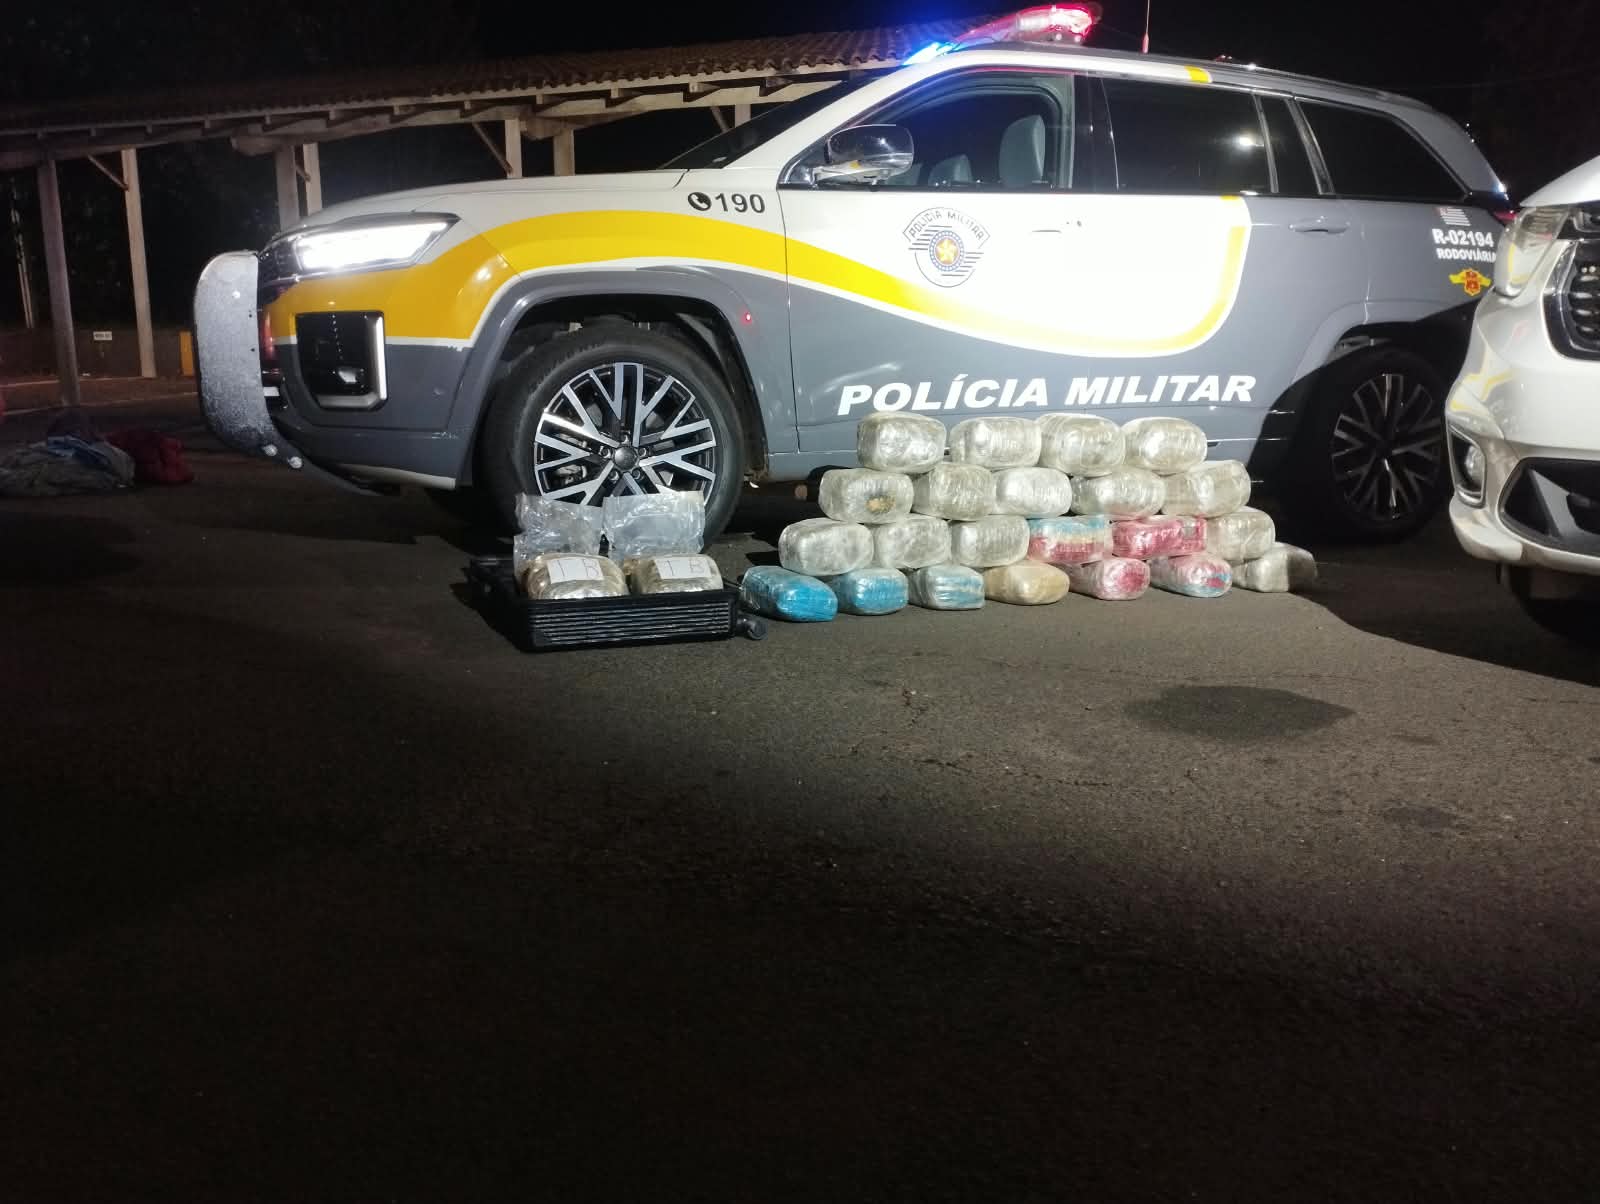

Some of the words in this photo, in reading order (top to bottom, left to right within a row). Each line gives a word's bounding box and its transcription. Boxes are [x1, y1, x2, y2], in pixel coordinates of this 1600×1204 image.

[715, 192, 766, 213] 190
[1432, 228, 1495, 248] R-02194
[837, 374, 1049, 416] POLÍCIA
[1064, 375, 1257, 406] MILITAR
